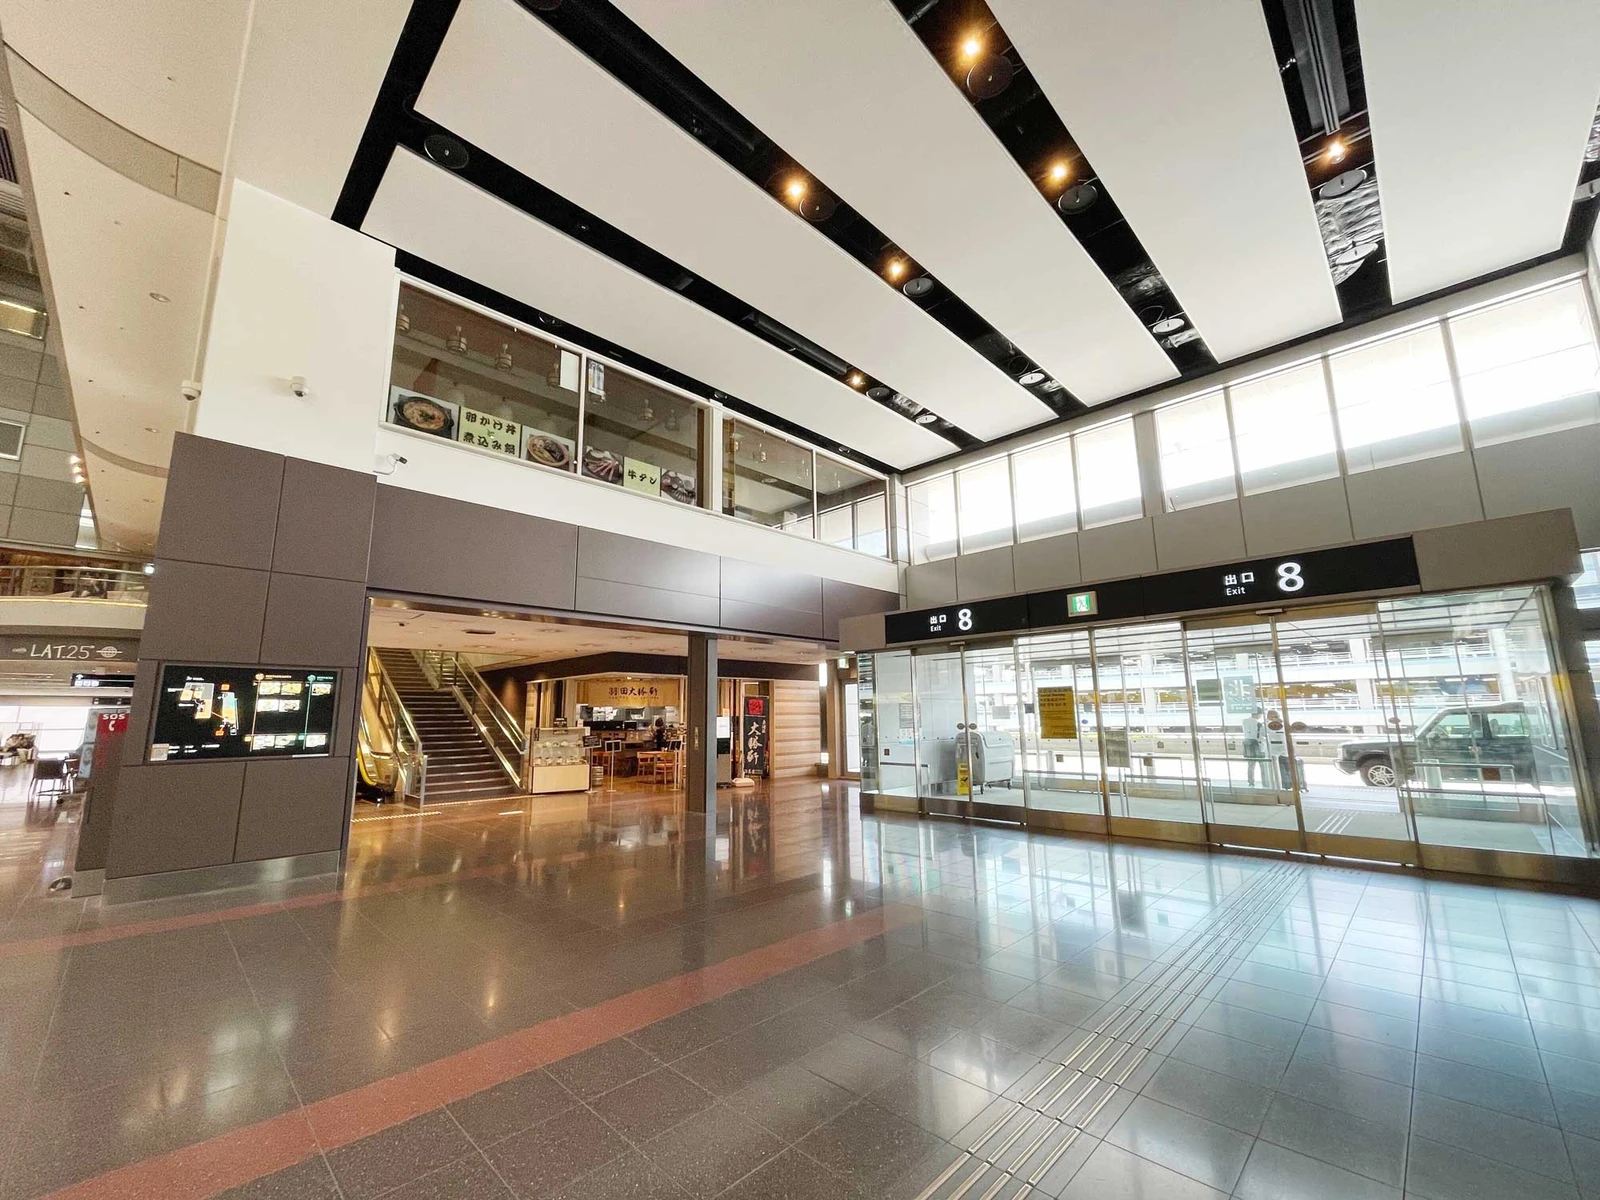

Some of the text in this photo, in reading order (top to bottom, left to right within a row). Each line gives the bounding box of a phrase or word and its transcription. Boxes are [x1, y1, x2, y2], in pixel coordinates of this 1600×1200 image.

[628, 469, 657, 484] 牛タン
[1225, 572, 1254, 585] 出口
[1278, 562, 1304, 592] 8
[1226, 587, 1246, 596] Exit
[930, 614, 947, 625] 出口
[958, 608, 972, 631] 8
